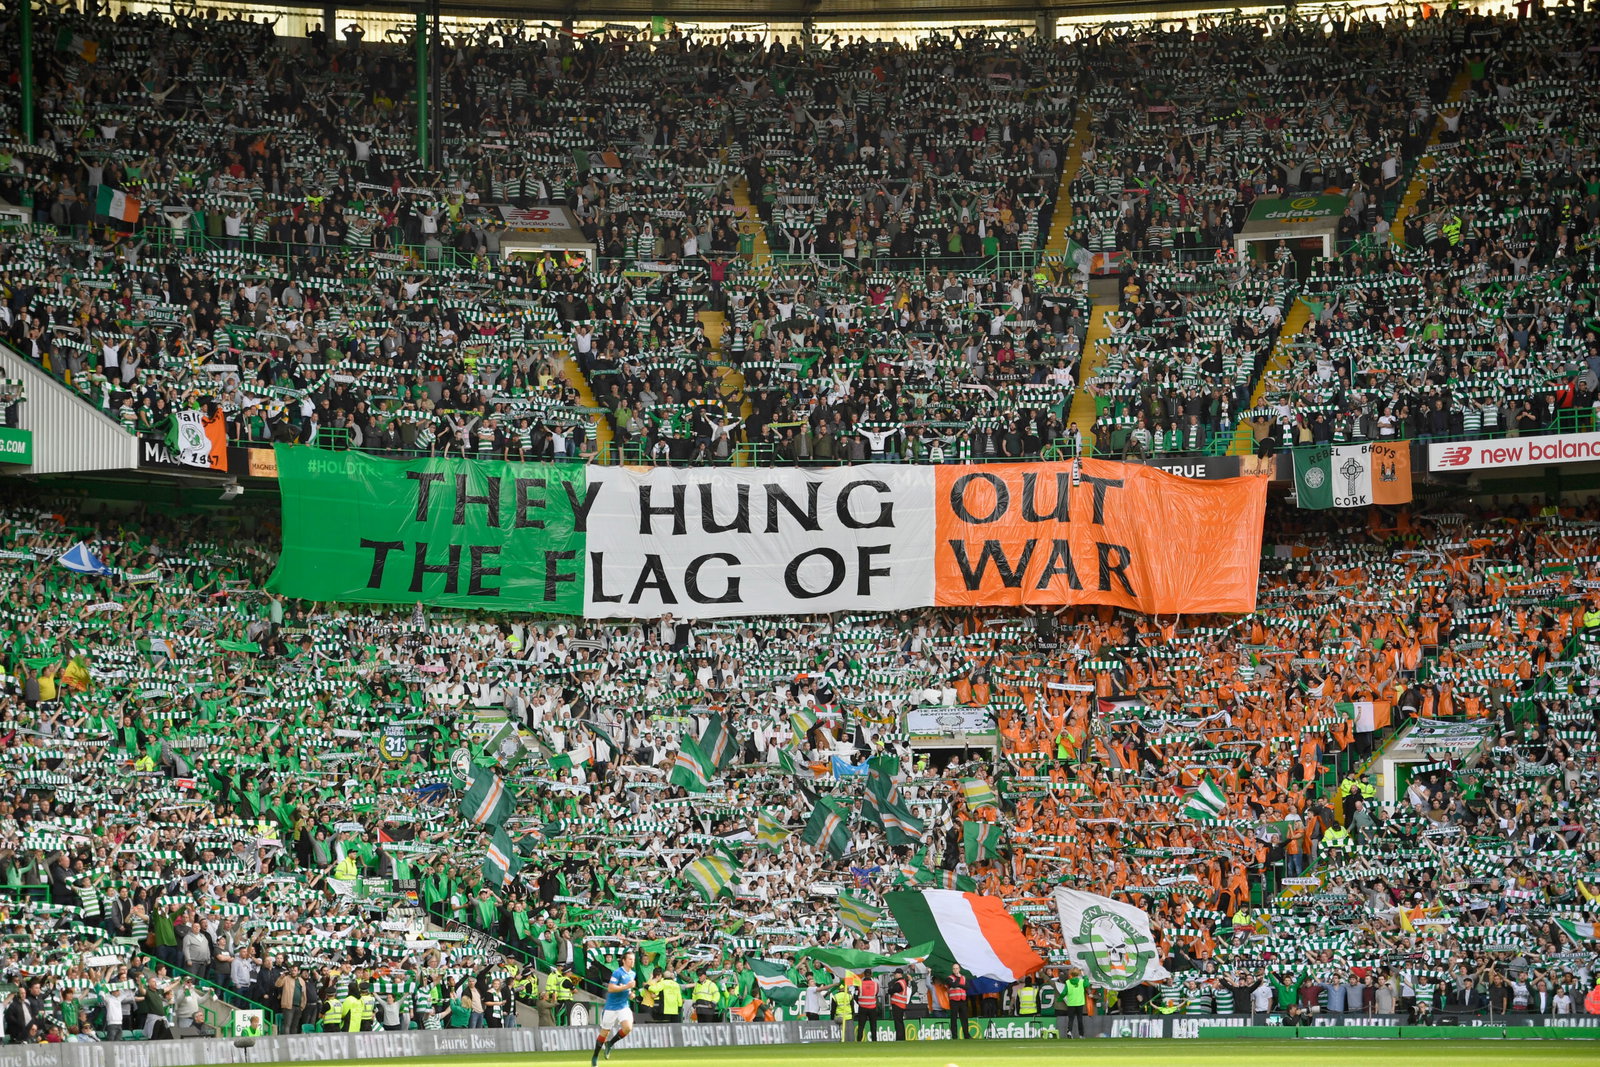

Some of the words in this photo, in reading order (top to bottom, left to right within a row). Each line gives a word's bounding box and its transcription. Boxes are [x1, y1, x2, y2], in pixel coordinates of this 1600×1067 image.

[1265, 208, 1332, 219] dafabet
[1308, 447, 1341, 465] REBEL
[1361, 444, 1396, 459] BHOYS
[1481, 446, 1524, 464] new
[1155, 464, 1206, 478] TRUE
[406, 470, 603, 533] THEY
[638, 479, 896, 536] HUNG
[950, 471, 1124, 525] OUT
[1334, 495, 1367, 506] CORK
[360, 537, 502, 597] THE
[543, 549, 744, 606] FLAG
[784, 543, 892, 600] OF
[948, 538, 1137, 598] WAR
[385, 736, 407, 752] 313
[363, 879, 389, 887] Glasgow's
[681, 1025, 731, 1047] PAISLEY
[799, 1025, 829, 1040] Laurie
[917, 1024, 952, 1041] dafabe
[434, 1034, 468, 1050] Laurie
[471, 1034, 496, 1049] Ross
[26, 1050, 58, 1067] Ross
